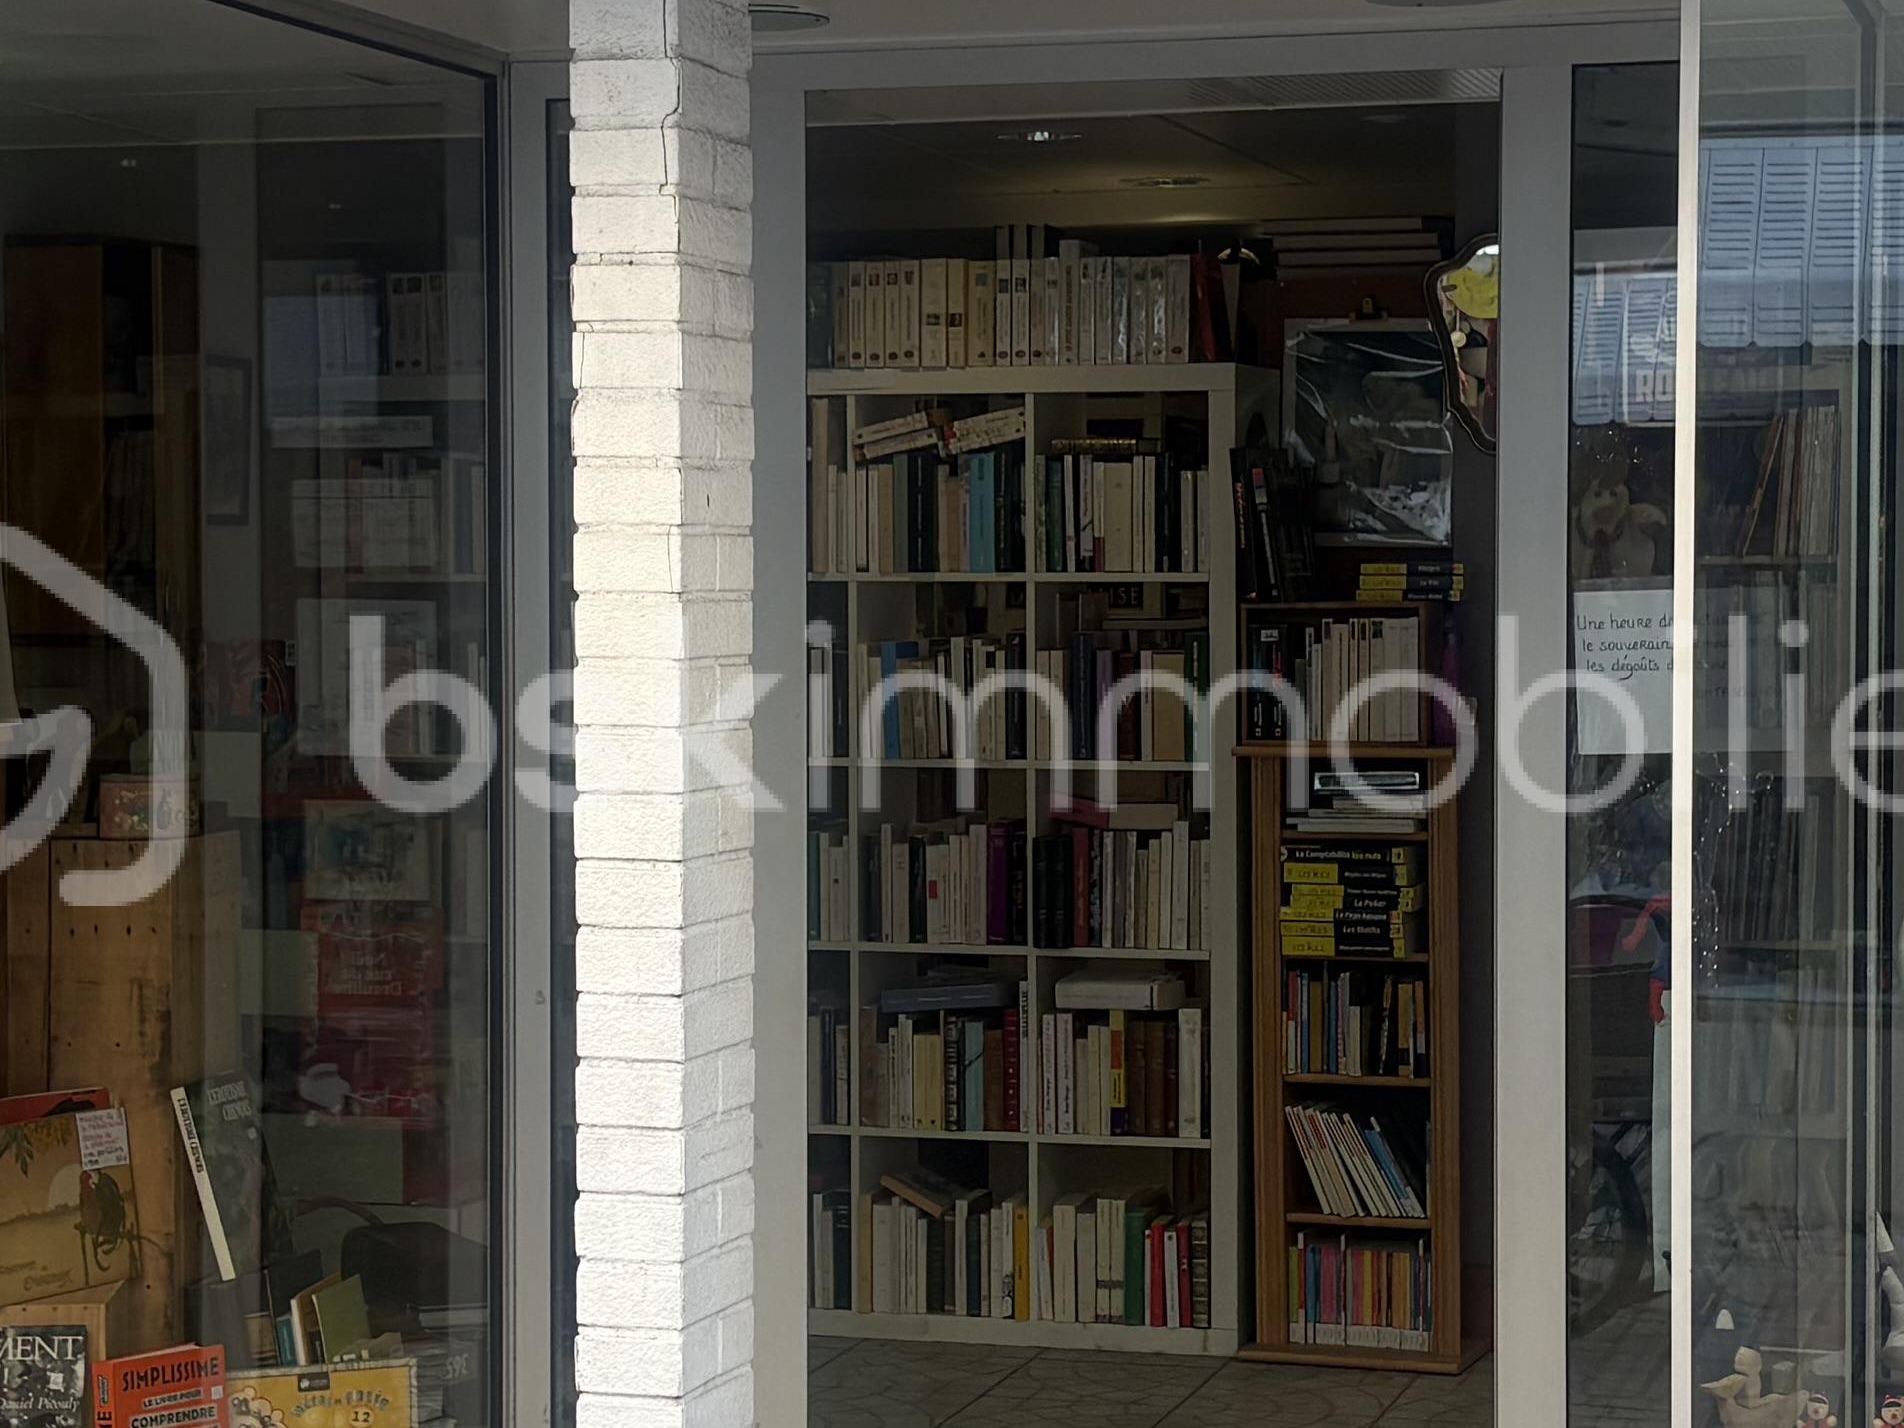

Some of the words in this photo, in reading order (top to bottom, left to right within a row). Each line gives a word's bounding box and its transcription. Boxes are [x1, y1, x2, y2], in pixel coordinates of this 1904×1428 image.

[1576, 615, 1606, 631] Une
[1610, 614, 1652, 629] heure
[1583, 639, 1593, 652] le
[1599, 640, 1673, 653] souverain
[1586, 659, 1605, 671] les
[1611, 654, 1661, 680] dégoûts
[122, 1358, 219, 1392] SIMPLISSIME
[352, 1411, 370, 1422] 12
